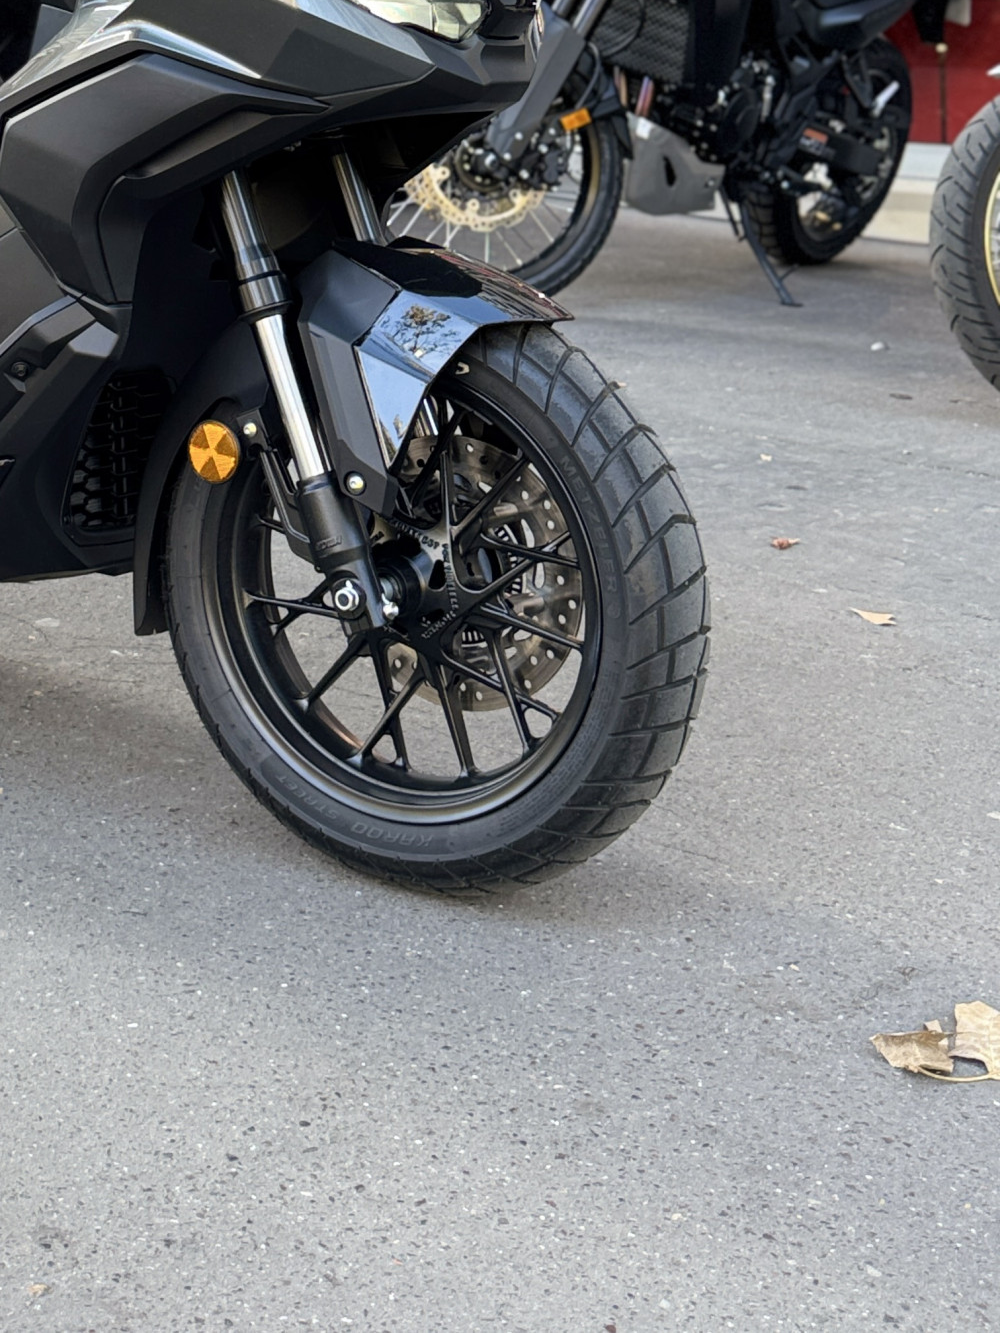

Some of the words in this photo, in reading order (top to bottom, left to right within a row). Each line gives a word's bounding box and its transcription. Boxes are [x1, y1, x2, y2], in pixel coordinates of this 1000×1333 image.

[560, 454, 618, 593] METZELER
[275, 773, 340, 820] STREET
[351, 821, 434, 848] KAROO
